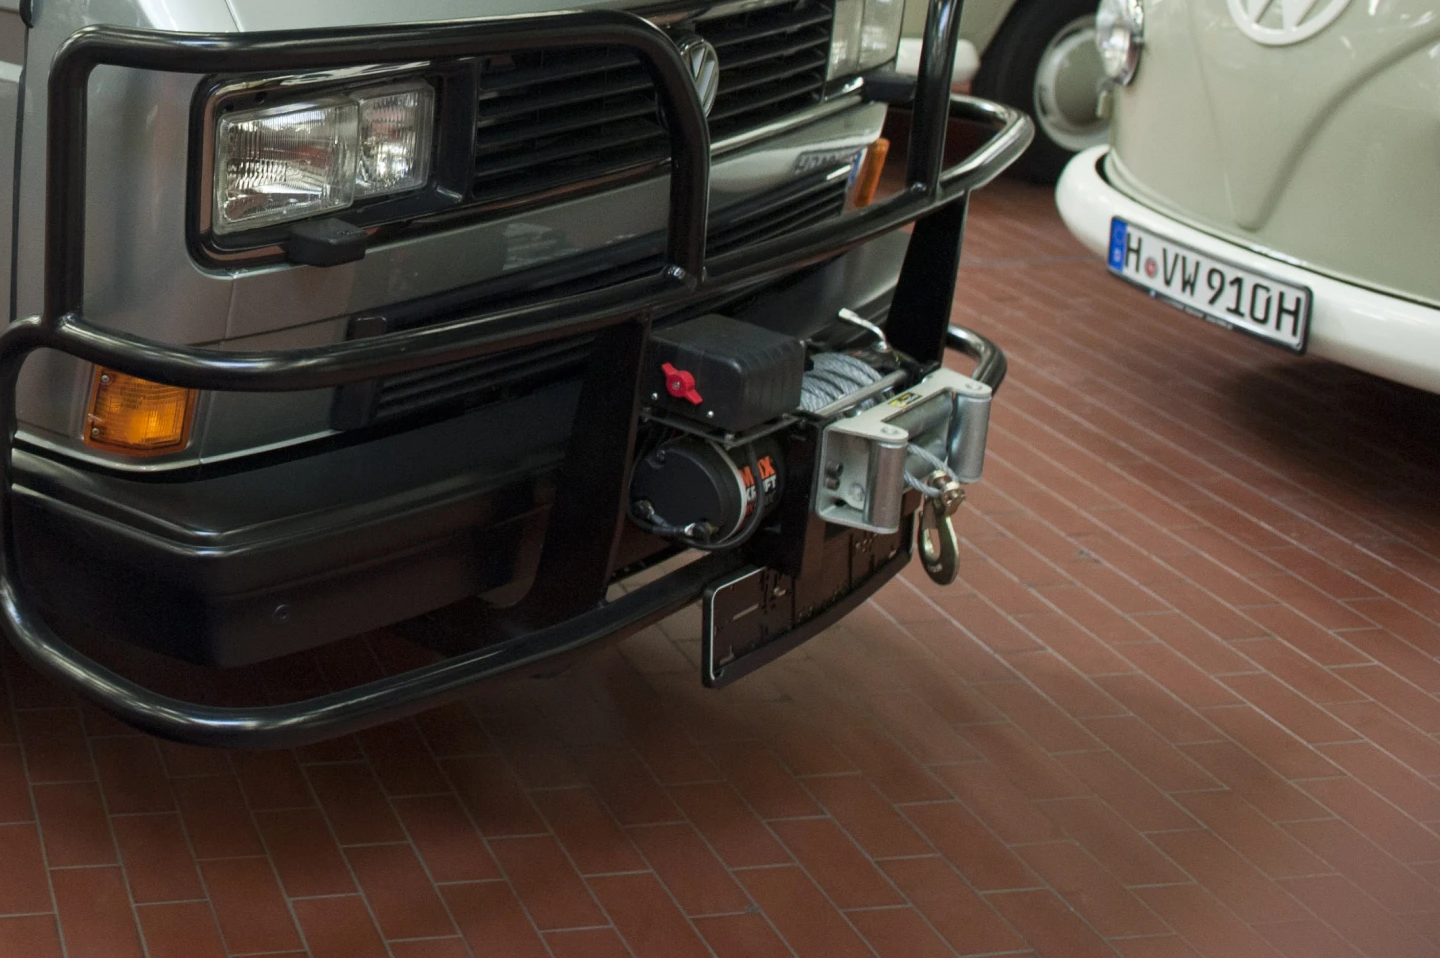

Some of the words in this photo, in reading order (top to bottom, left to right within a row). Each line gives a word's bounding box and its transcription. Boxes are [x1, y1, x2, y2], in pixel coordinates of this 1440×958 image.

[1124, 232, 1143, 274] H
[1162, 247, 1200, 298] VW
[1207, 267, 1302, 338] 910H
